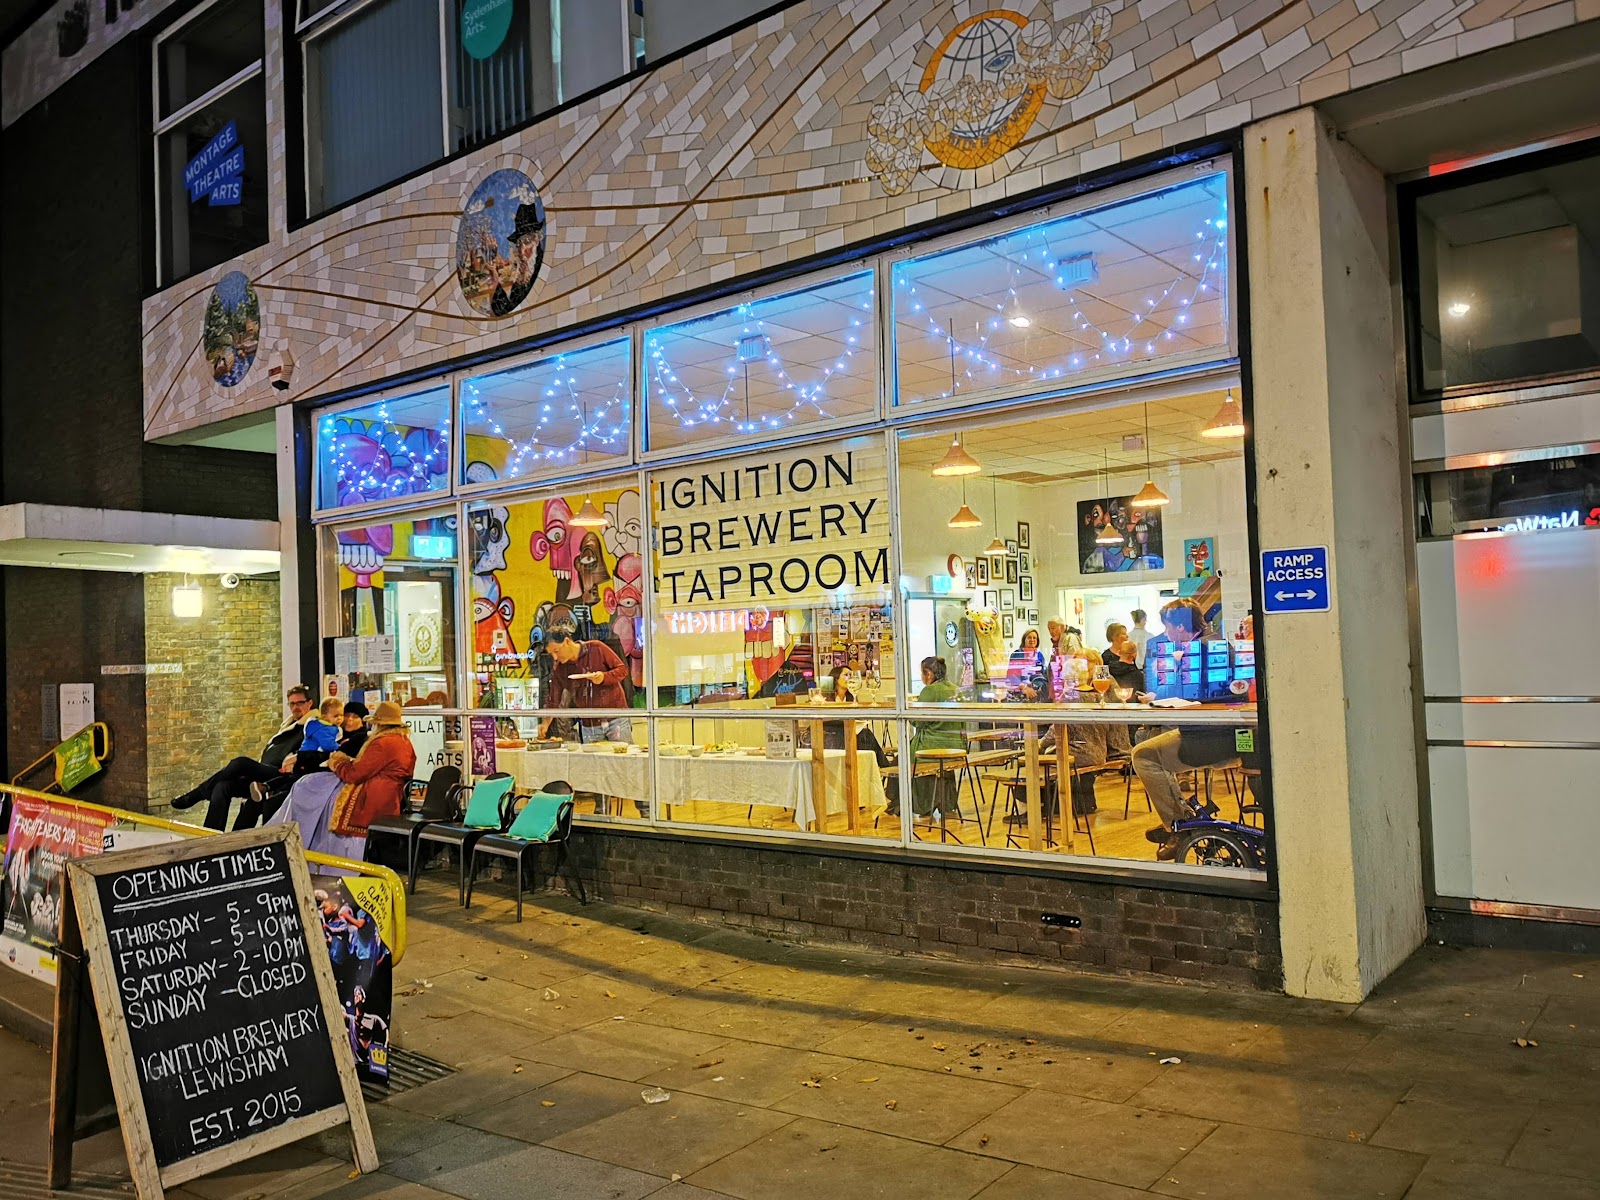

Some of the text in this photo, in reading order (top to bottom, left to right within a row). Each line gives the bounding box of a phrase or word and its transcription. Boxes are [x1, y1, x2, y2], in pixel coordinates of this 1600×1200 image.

[185, 126, 234, 184] MONTAGE
[193, 153, 240, 195] THEATRE
[211, 183, 240, 200] ARTS
[659, 451, 854, 512] IGNITION
[661, 498, 878, 557] BREWERY
[662, 548, 890, 605] TAPROOM
[1266, 567, 1324, 582] ACCESS
[1273, 554, 1314, 568] RAMP
[426, 752, 463, 767] ARTS
[112, 846, 276, 900] OPENING TIMES
[356, 891, 377, 914] OPEN
[120, 938, 188, 974] FRIDAY
[127, 984, 207, 1029] SUNDAY
[141, 1004, 321, 1083] IGNITION BREWERY
[178, 1045, 289, 1100] LEWISHAM
[189, 1086, 302, 1145] EST. 2015
